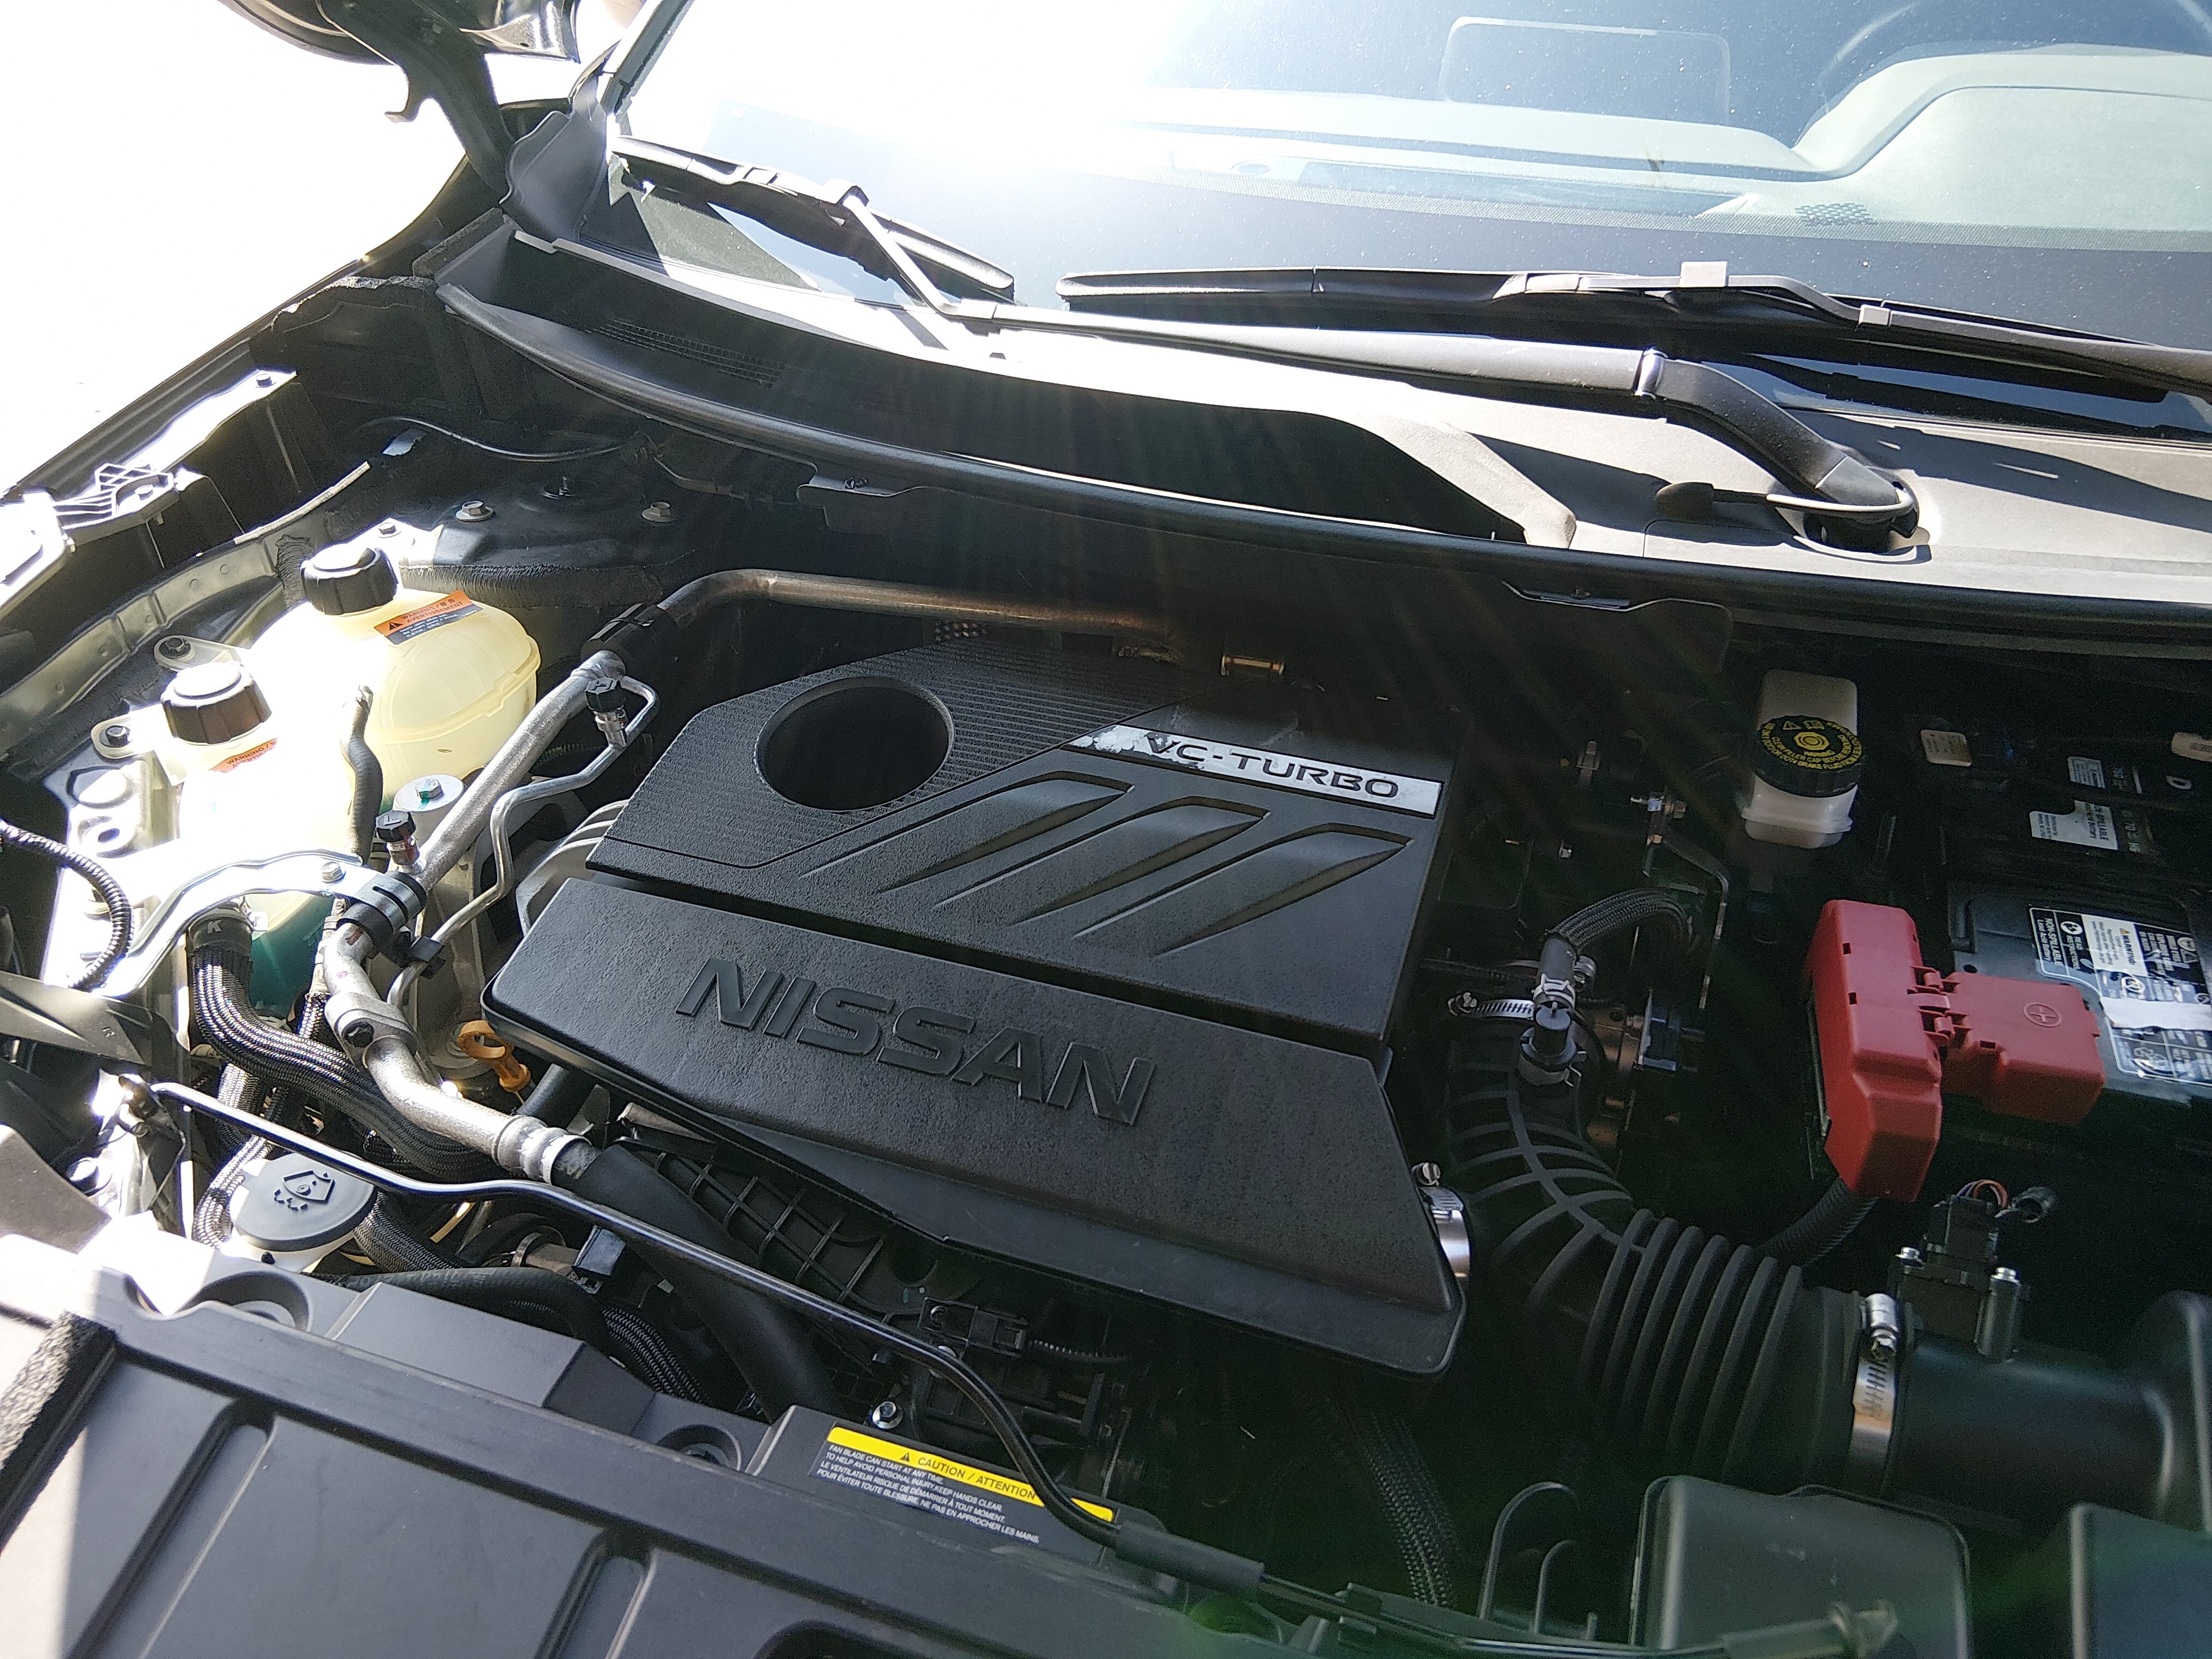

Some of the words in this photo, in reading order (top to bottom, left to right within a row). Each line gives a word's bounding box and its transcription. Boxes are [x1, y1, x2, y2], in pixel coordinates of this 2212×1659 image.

[1146, 736, 1399, 799] VC-TURBO
[1797, 761, 1822, 769] BRAKE
[208, 919, 222, 934] K
[675, 956, 1155, 1127] NISSAN
[829, 1444, 843, 1454] FAN
[843, 1449, 866, 1461] BLADE
[866, 1456, 881, 1465] CAN
[881, 1460, 902, 1471] START
[911, 1469, 927, 1478] ANY
[835, 1456, 853, 1465] HELP
[854, 1462, 875, 1471] AVOID
[875, 1467, 910, 1483] PERSONAL
[953, 1492, 978, 1504] HANDS
[918, 1457, 966, 1478] CAUTION
[976, 1476, 1036, 1500] ATTENTION
[817, 1468, 837, 1480] POUR
[837, 1473, 861, 1486] ÉVITER
[861, 1482, 883, 1494] TOUTE
[921, 1500, 931, 1509] NE
[931, 1503, 946, 1514] PAS
[946, 1508, 957, 1517] EN
[957, 1512, 1002, 1531] APPROCHER
[1002, 1525, 1016, 1535] LES
[831, 1463, 873, 1482] VENTILATEUR
[873, 1476, 899, 1489] RISQUE
[899, 1484, 911, 1493] DE
[910, 1487, 948, 1504] DÉMARRER
[955, 1502, 974, 1513] TOUT
